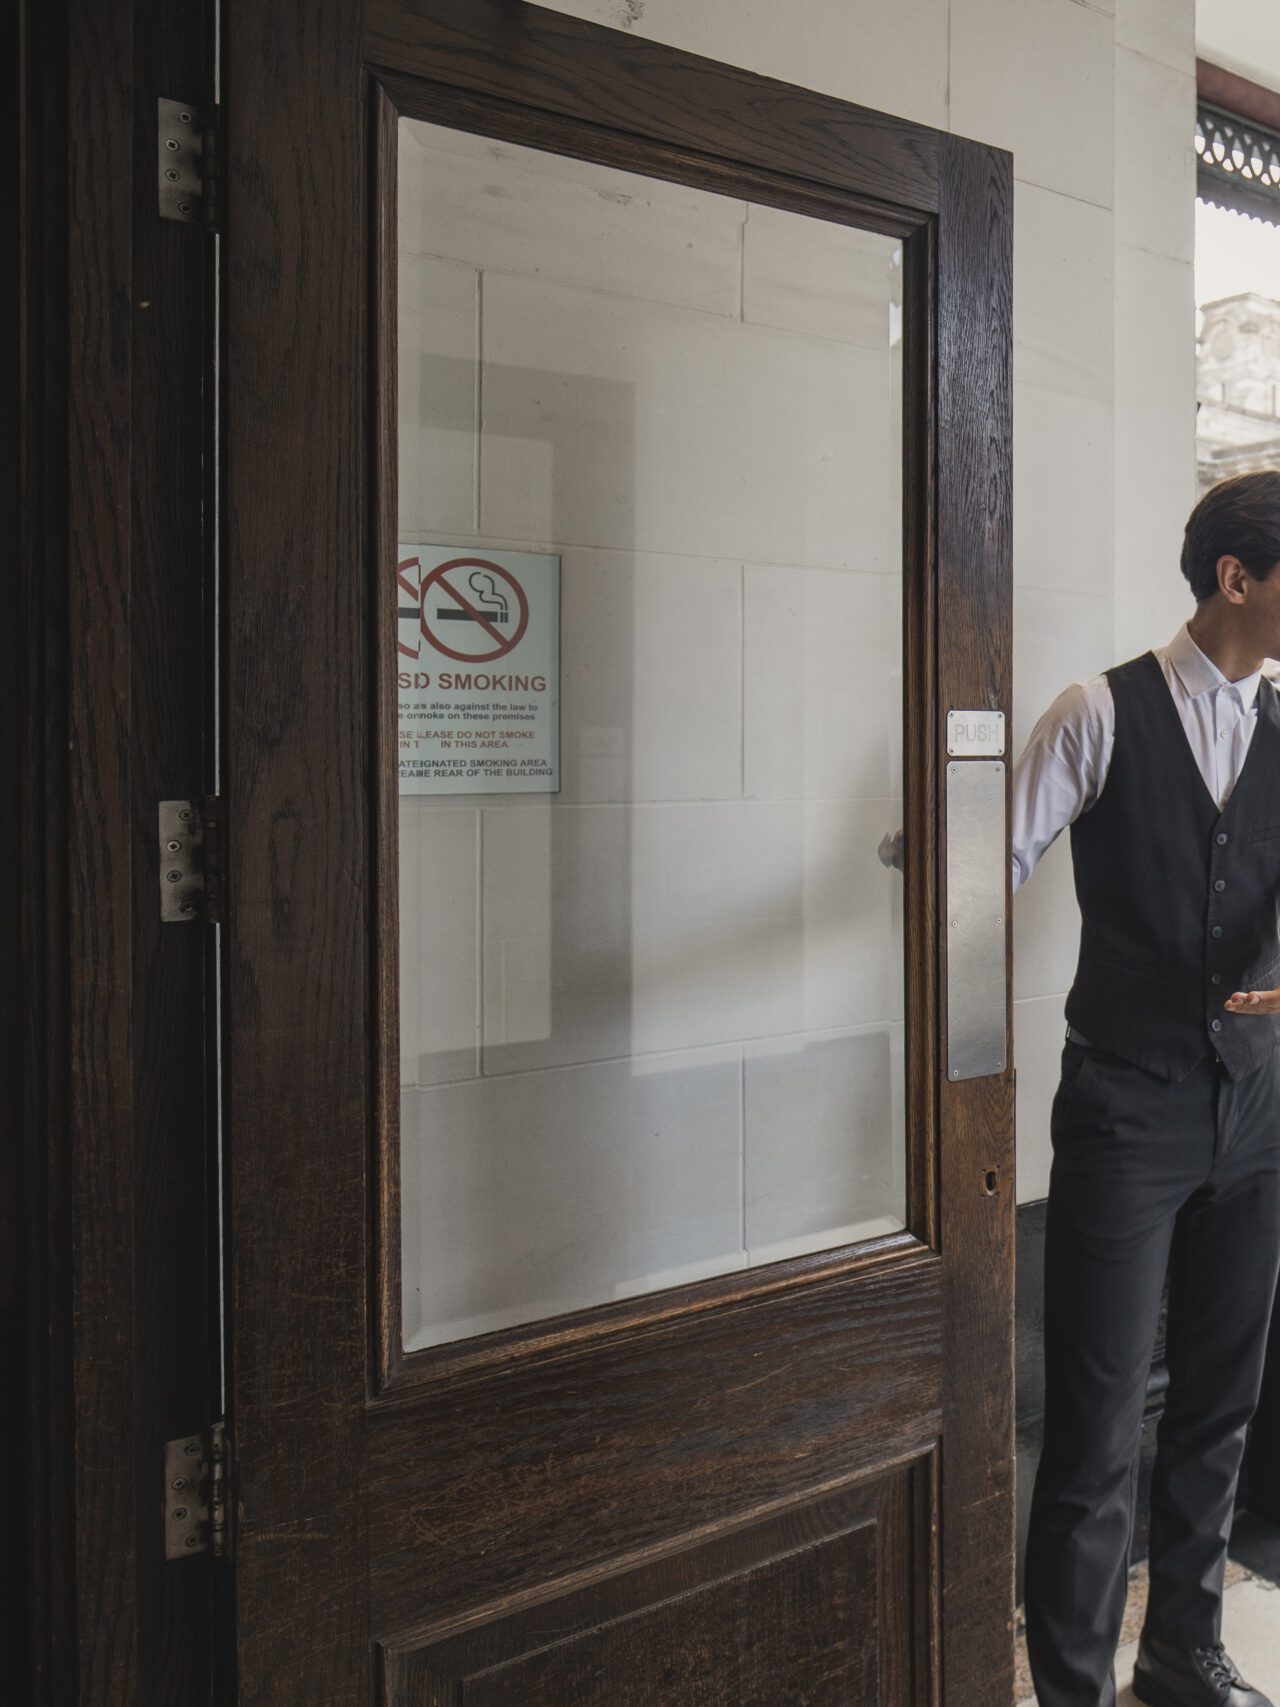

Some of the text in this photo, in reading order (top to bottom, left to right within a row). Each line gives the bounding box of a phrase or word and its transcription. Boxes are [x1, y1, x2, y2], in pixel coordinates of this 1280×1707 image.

[438, 672, 546, 692] SMOKING
[430, 702, 451, 710] also
[454, 702, 490, 712] against
[492, 703, 507, 711] the
[510, 703, 526, 711] law
[463, 712, 489, 720] these
[492, 713, 536, 722] premises
[457, 731, 472, 739] DO
[475, 731, 496, 739] NOT
[499, 731, 536, 739] SMOKE
[954, 724, 999, 742] PUSH
[470, 760, 518, 768] SMOKING
[434, 769, 463, 777] REAR
[466, 769, 481, 777] OF
[483, 769, 503, 777] THE
[506, 768, 553, 777] BUILDING
